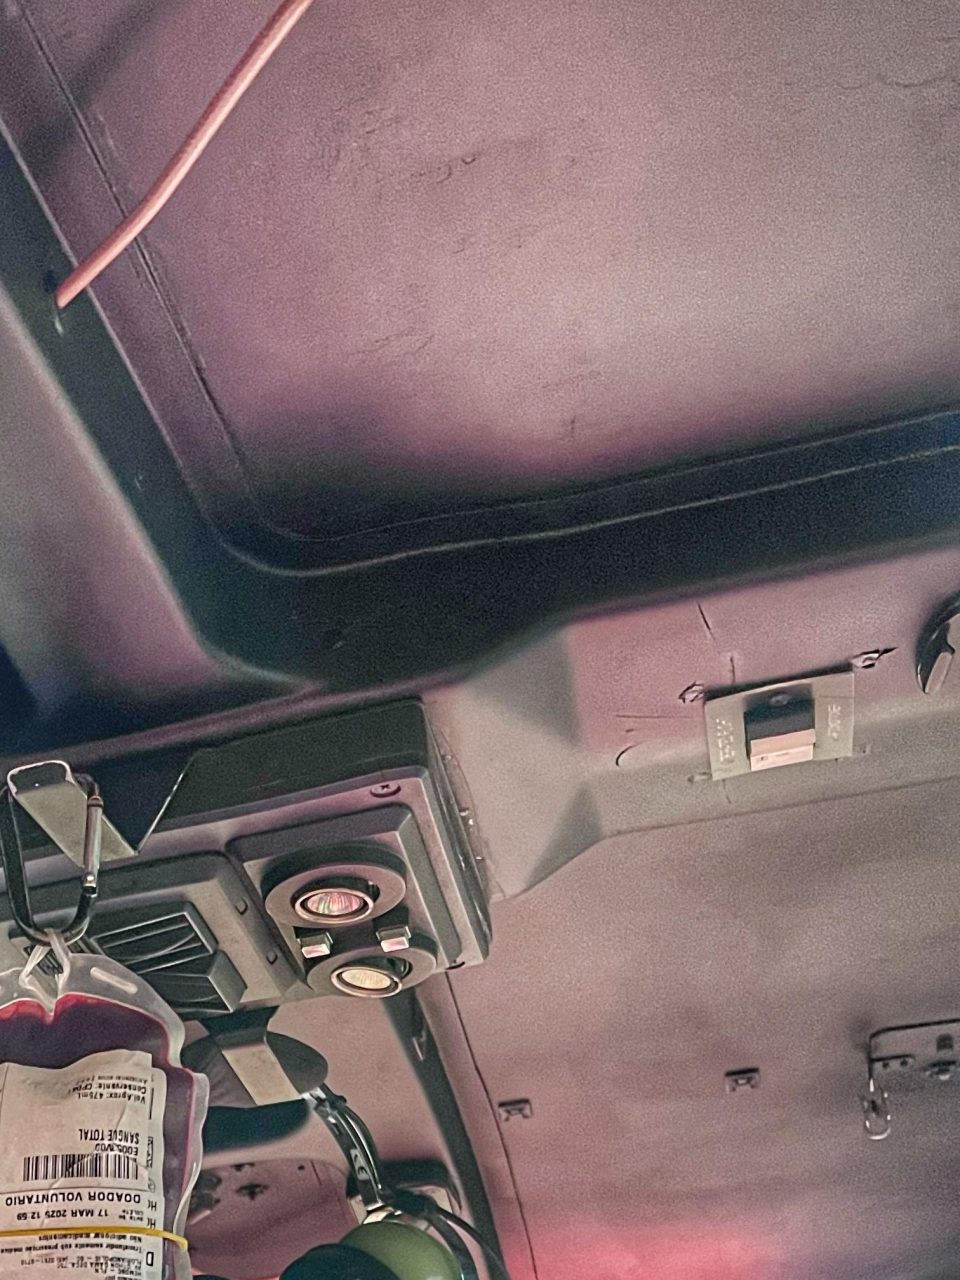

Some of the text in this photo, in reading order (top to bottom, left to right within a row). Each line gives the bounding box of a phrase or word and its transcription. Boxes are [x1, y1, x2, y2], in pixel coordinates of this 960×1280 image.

[78, 1129, 139, 1145] SANGUE TOTAL
[5, 1192, 141, 1206] DOADOR VOLUNTARIO
[45, 1209, 67, 1218] 2025
[71, 1209, 94, 1217] MAR
[98, 1209, 108, 1217] 17
